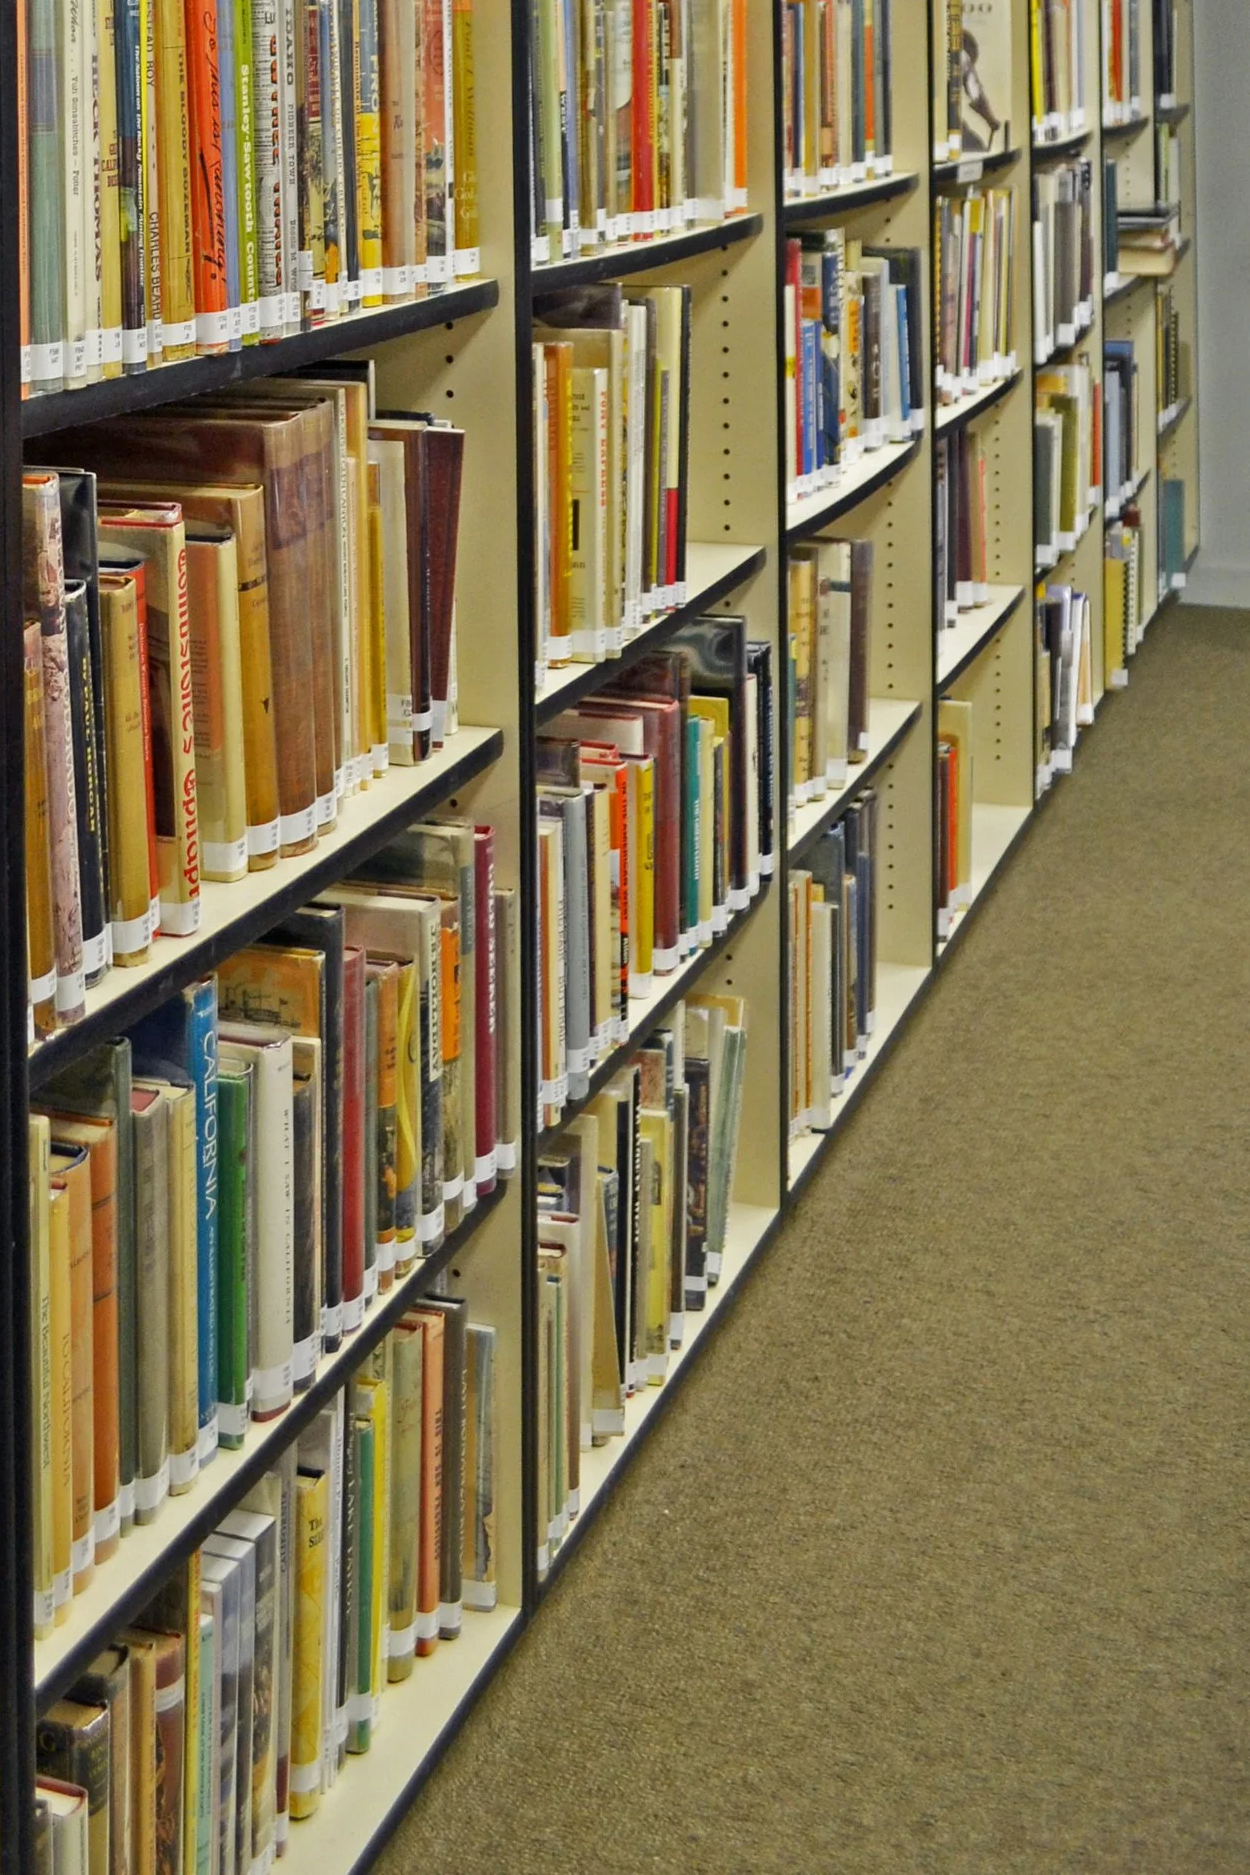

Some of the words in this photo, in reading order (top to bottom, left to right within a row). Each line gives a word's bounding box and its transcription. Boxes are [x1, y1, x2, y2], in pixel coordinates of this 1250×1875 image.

[465, 21, 473, 60] Paul
[146, 60, 155, 88] BOY
[180, 90, 188, 160] BLOODY
[287, 104, 295, 150] PIONEER
[466, 86, 475, 158] Wellman
[94, 152, 102, 281] THOMAS
[149, 211, 160, 274] CHARLES
[150, 277, 161, 320] BEARD
[202, 1030, 217, 1221] CALIFORNIA
[282, 1108, 290, 1153] WHAT
[283, 1172, 291, 1200] SAW
[283, 1208, 291, 1225] IN
[283, 1233, 292, 1325] CALIFORNIA
[40, 1295, 51, 1324] The
[40, 1325, 51, 1391] Beautiful
[41, 1394, 52, 1469] Northwest
